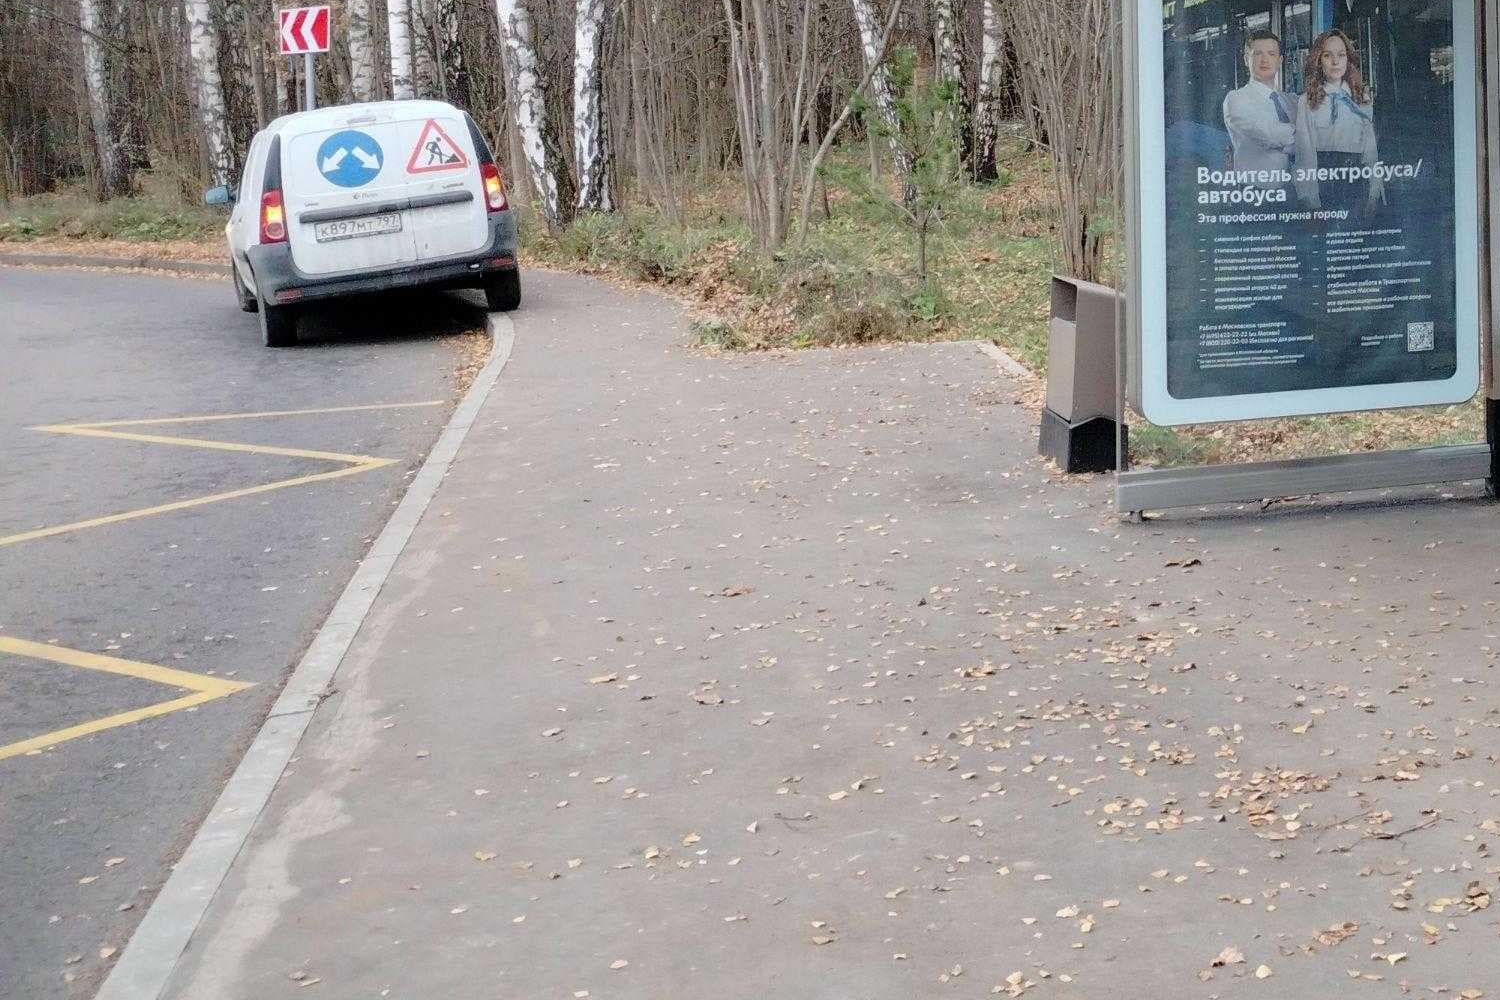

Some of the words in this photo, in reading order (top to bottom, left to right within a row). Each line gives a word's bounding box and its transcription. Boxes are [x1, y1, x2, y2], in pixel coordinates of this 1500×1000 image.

[1197, 166, 1291, 186] Водитель
[1296, 159, 1422, 183] электробуса/
[1198, 186, 1287, 206] автобуса
[1197, 213, 1217, 224] Эта
[1219, 212, 1276, 224] профессия
[1279, 211, 1312, 222] нужна
[1314, 210, 1349, 220] городу
